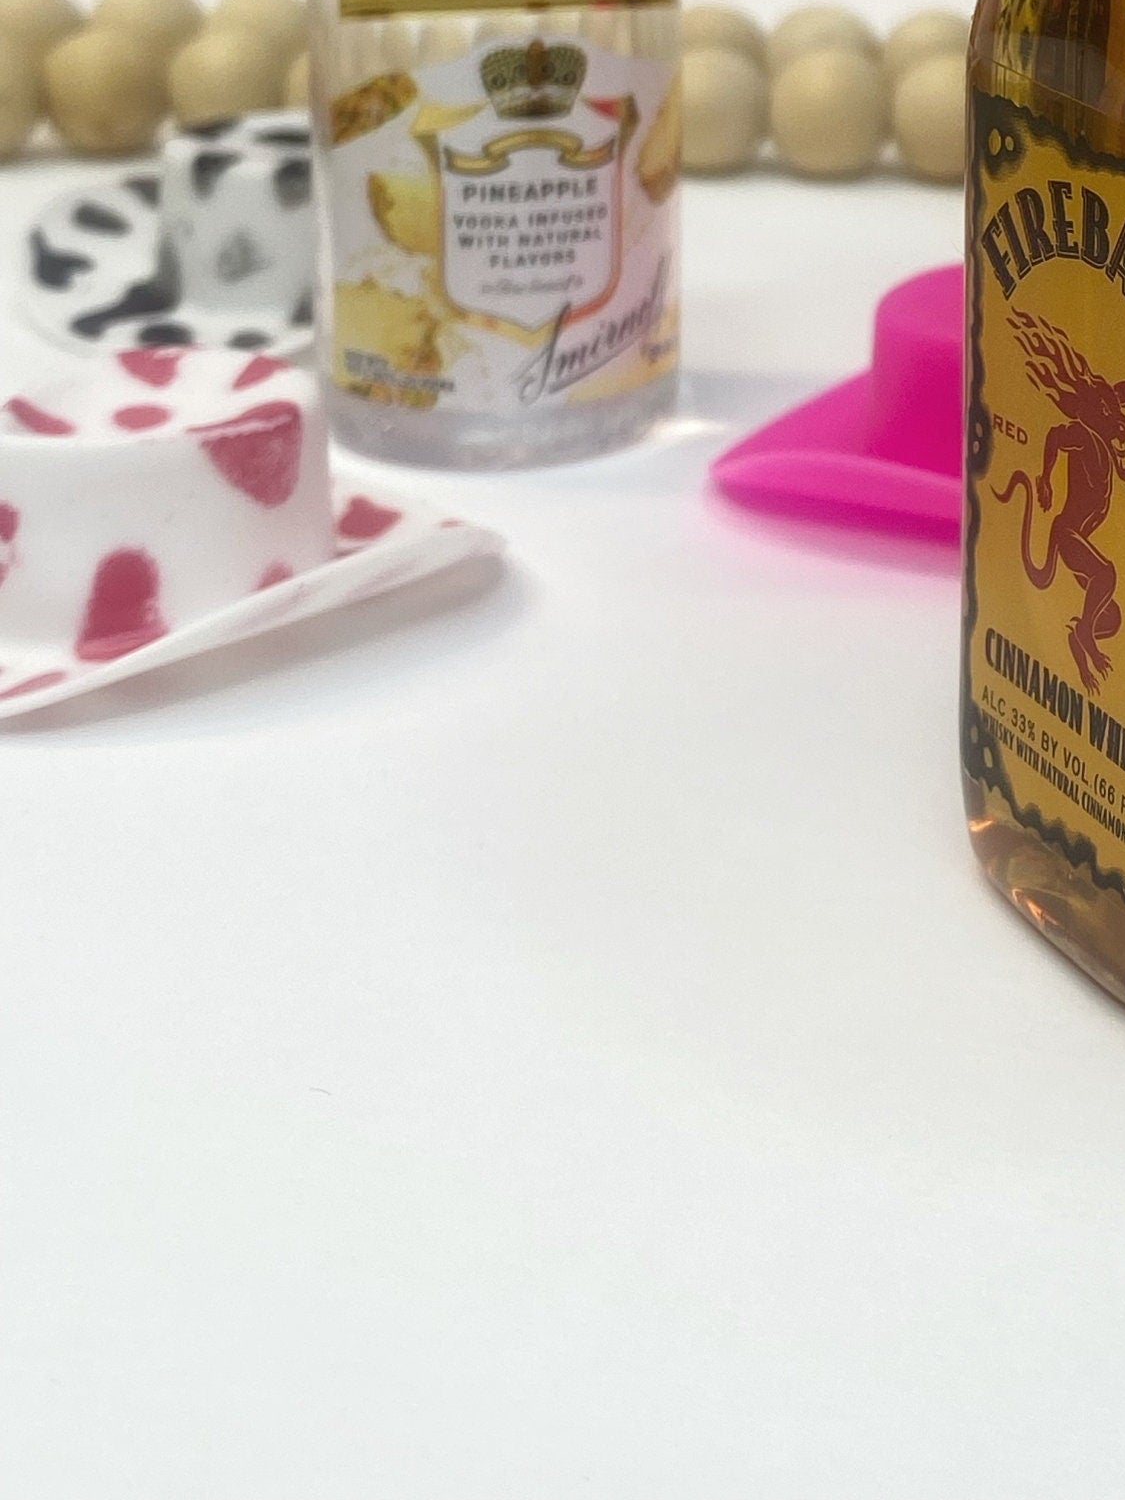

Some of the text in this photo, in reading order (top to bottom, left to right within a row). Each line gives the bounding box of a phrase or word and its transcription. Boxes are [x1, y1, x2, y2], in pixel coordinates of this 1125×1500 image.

[462, 175, 598, 202] PINEAPPLE
[453, 202, 608, 229] VODKA INFUSED
[458, 228, 602, 248] WITH NATURAL
[490, 248, 576, 268] FLAVORS
[993, 412, 1028, 446] RED
[985, 627, 1083, 736] CINNAMON
[981, 685, 1006, 717] ALC
[1011, 708, 1036, 742] 33%
[1041, 730, 1058, 759] BY
[1093, 773, 1116, 805] (66
[1017, 736, 1040, 772] WITH
[1041, 756, 1080, 806] NATURAL
